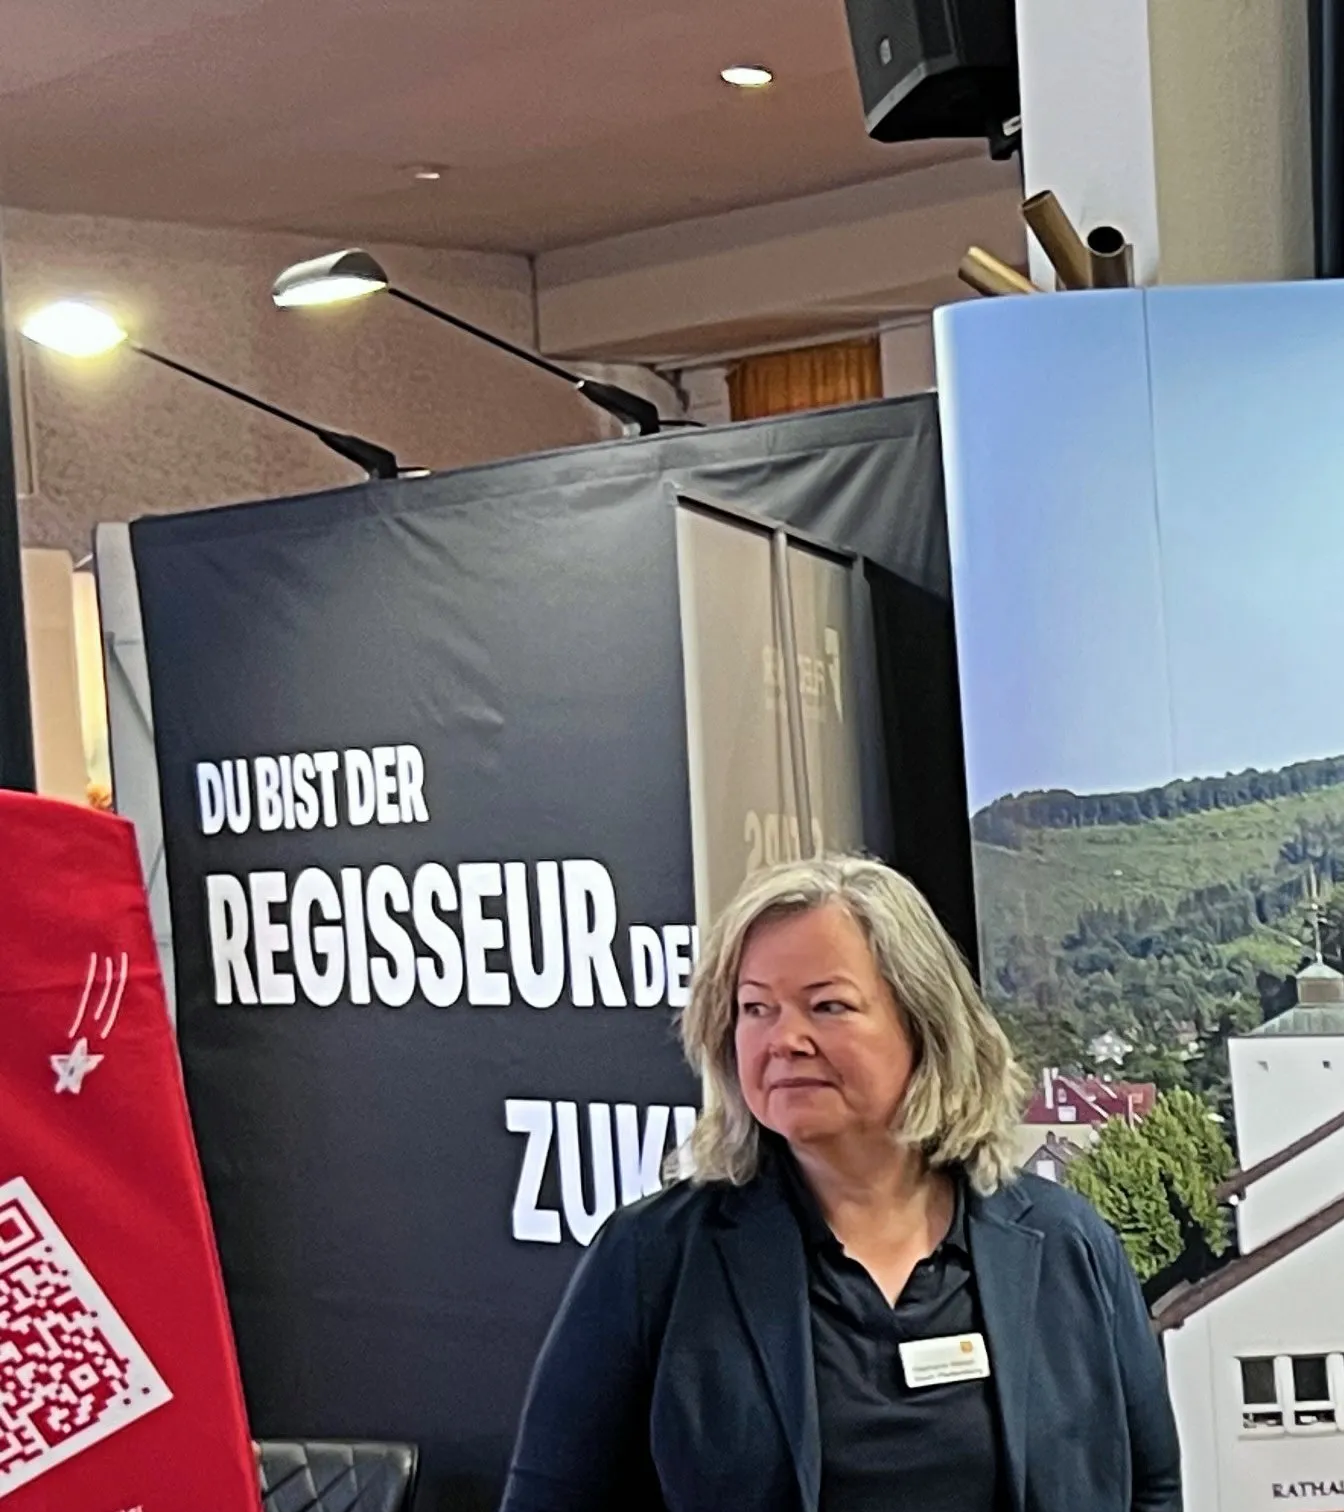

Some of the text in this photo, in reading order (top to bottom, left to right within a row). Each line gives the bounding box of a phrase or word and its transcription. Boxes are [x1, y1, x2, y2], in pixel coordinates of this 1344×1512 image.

[196, 745, 429, 836] DU BIST DER
[205, 859, 627, 1009] REGISSEUR
